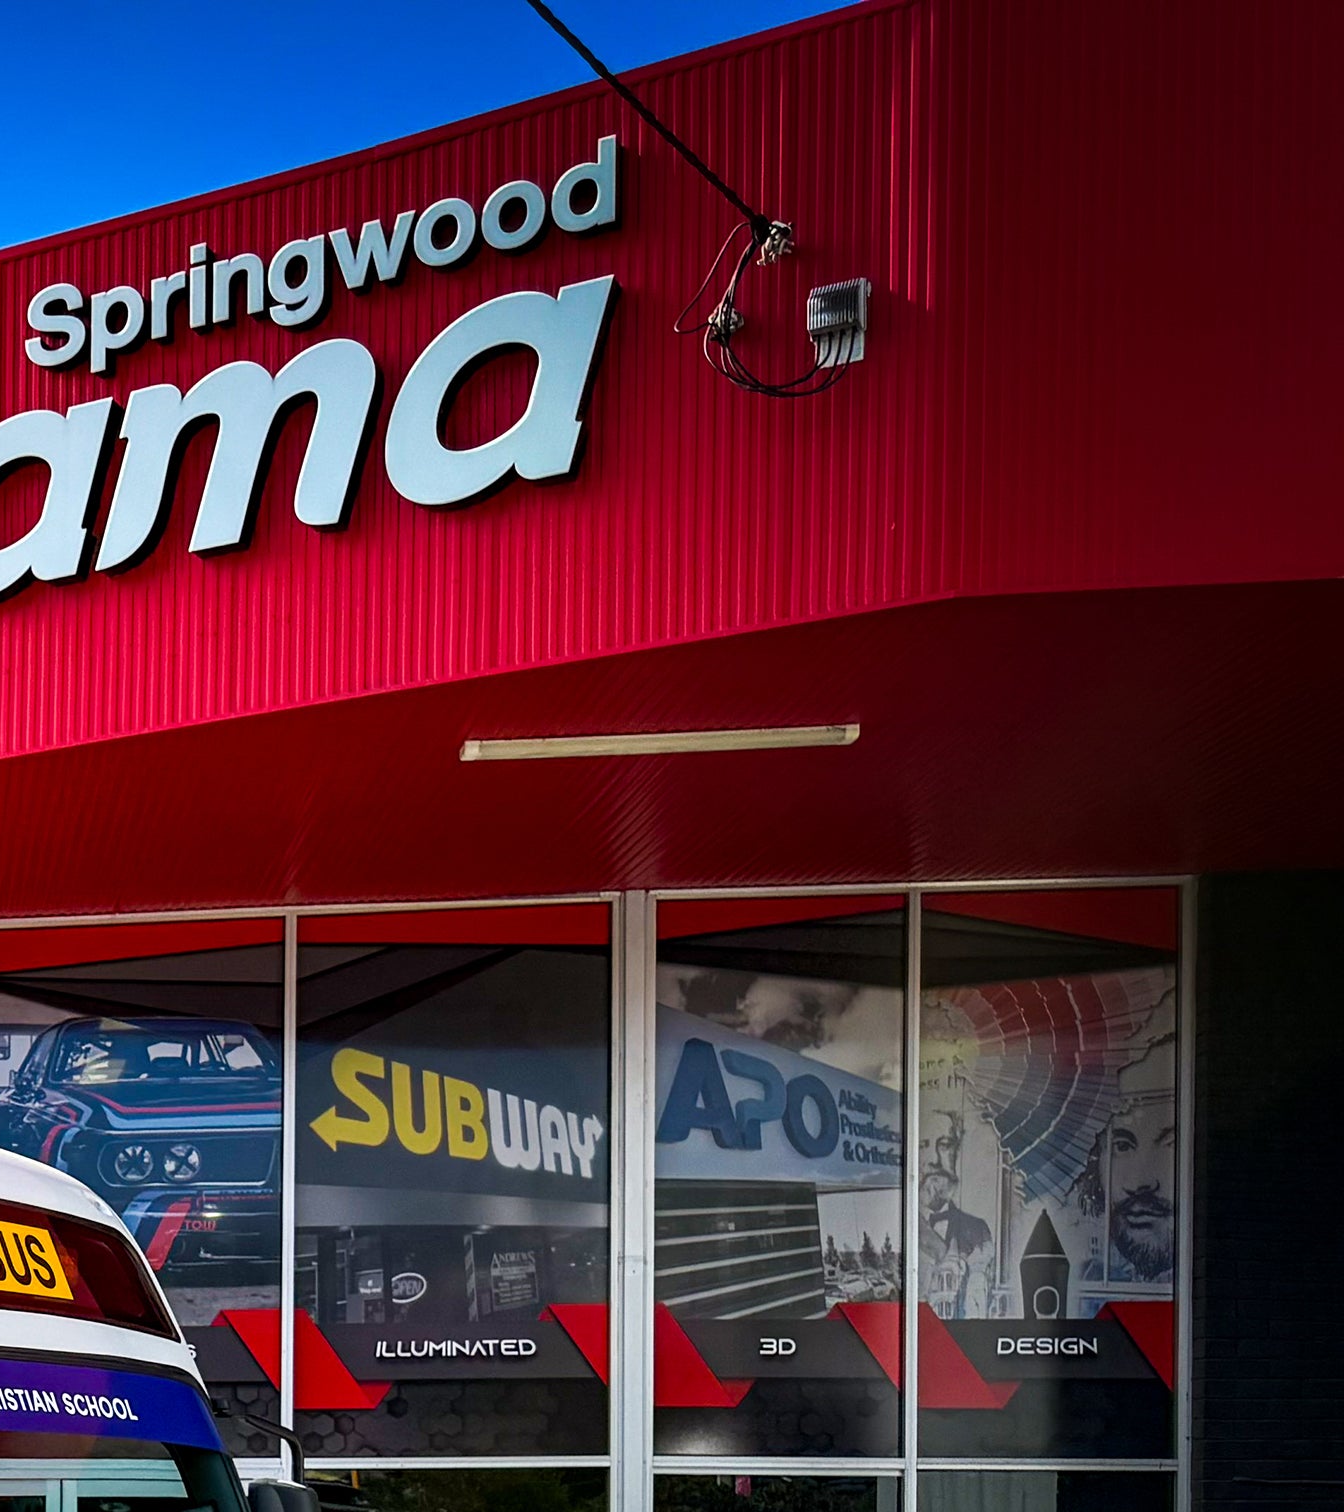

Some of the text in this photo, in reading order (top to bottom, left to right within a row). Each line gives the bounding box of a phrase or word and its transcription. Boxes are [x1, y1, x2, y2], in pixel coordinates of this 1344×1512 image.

[25, 135, 617, 374] Springwood
[310, 1047, 604, 1179] SUBWAY
[655, 1037, 840, 1160] APO
[838, 1088, 877, 1120] Ability
[375, 1339, 537, 1358] ILLUMINATED
[759, 1338, 796, 1355] 3D
[996, 1337, 1098, 1355] DESIGN
[61, 1392, 139, 1421] SCHOOL
